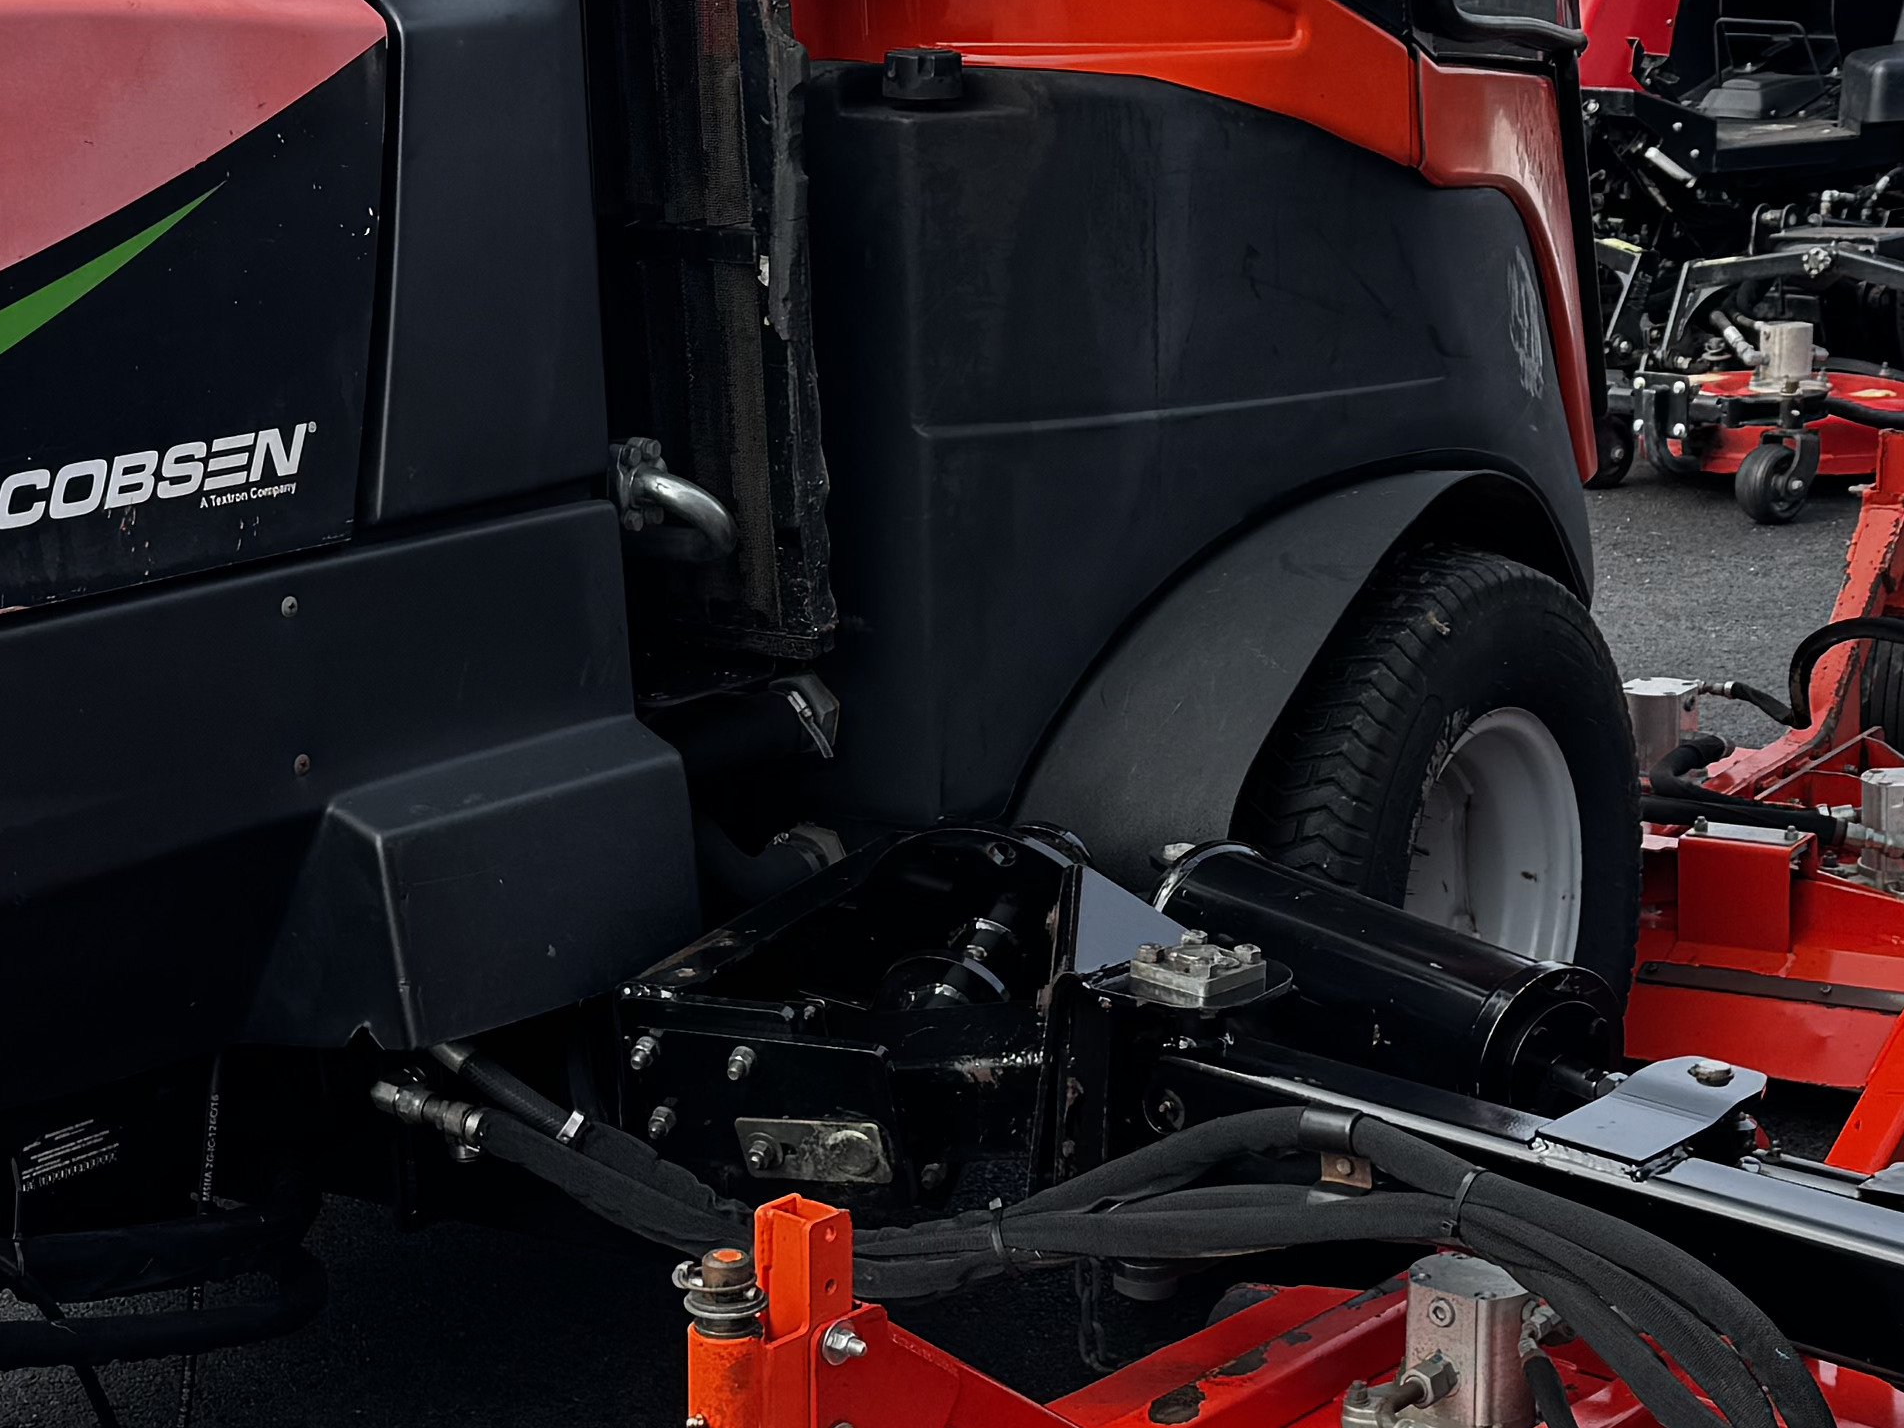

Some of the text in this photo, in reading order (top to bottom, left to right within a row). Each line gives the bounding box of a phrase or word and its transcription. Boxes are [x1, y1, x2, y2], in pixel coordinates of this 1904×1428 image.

[200, 482, 297, 509] A Textron Company
